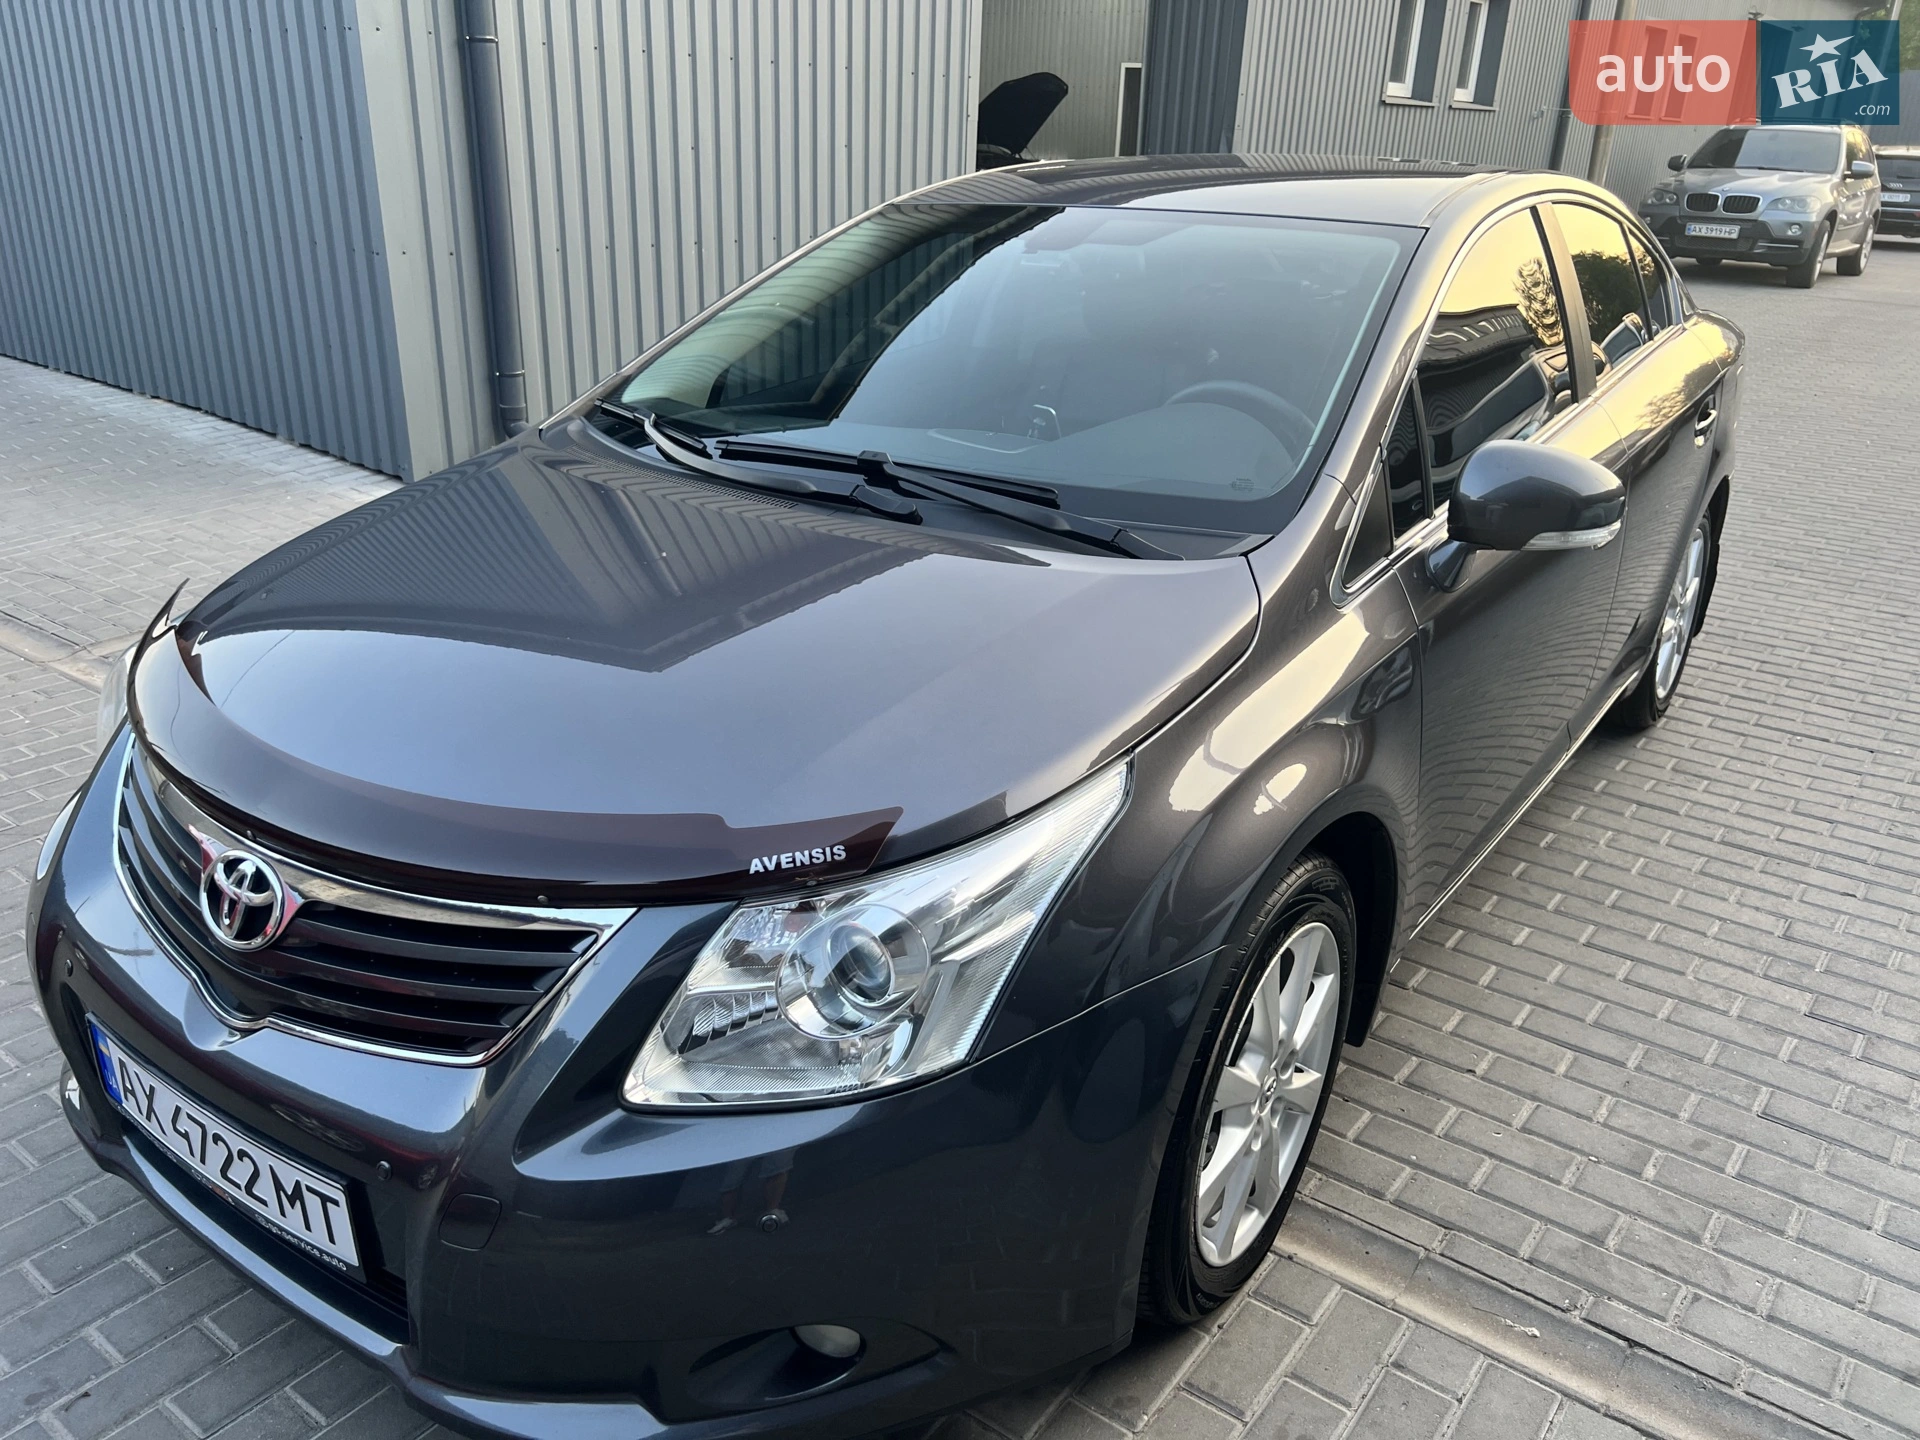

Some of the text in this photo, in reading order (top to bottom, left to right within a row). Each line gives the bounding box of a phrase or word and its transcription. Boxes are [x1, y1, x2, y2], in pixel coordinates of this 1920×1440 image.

[1692, 225, 1704, 234] AX
[749, 844, 847, 875] AVENSIS
[104, 1069, 119, 1092] UA
[118, 1056, 168, 1137] AX
[171, 1104, 269, 1208] 4722
[268, 1163, 341, 1246] MT
